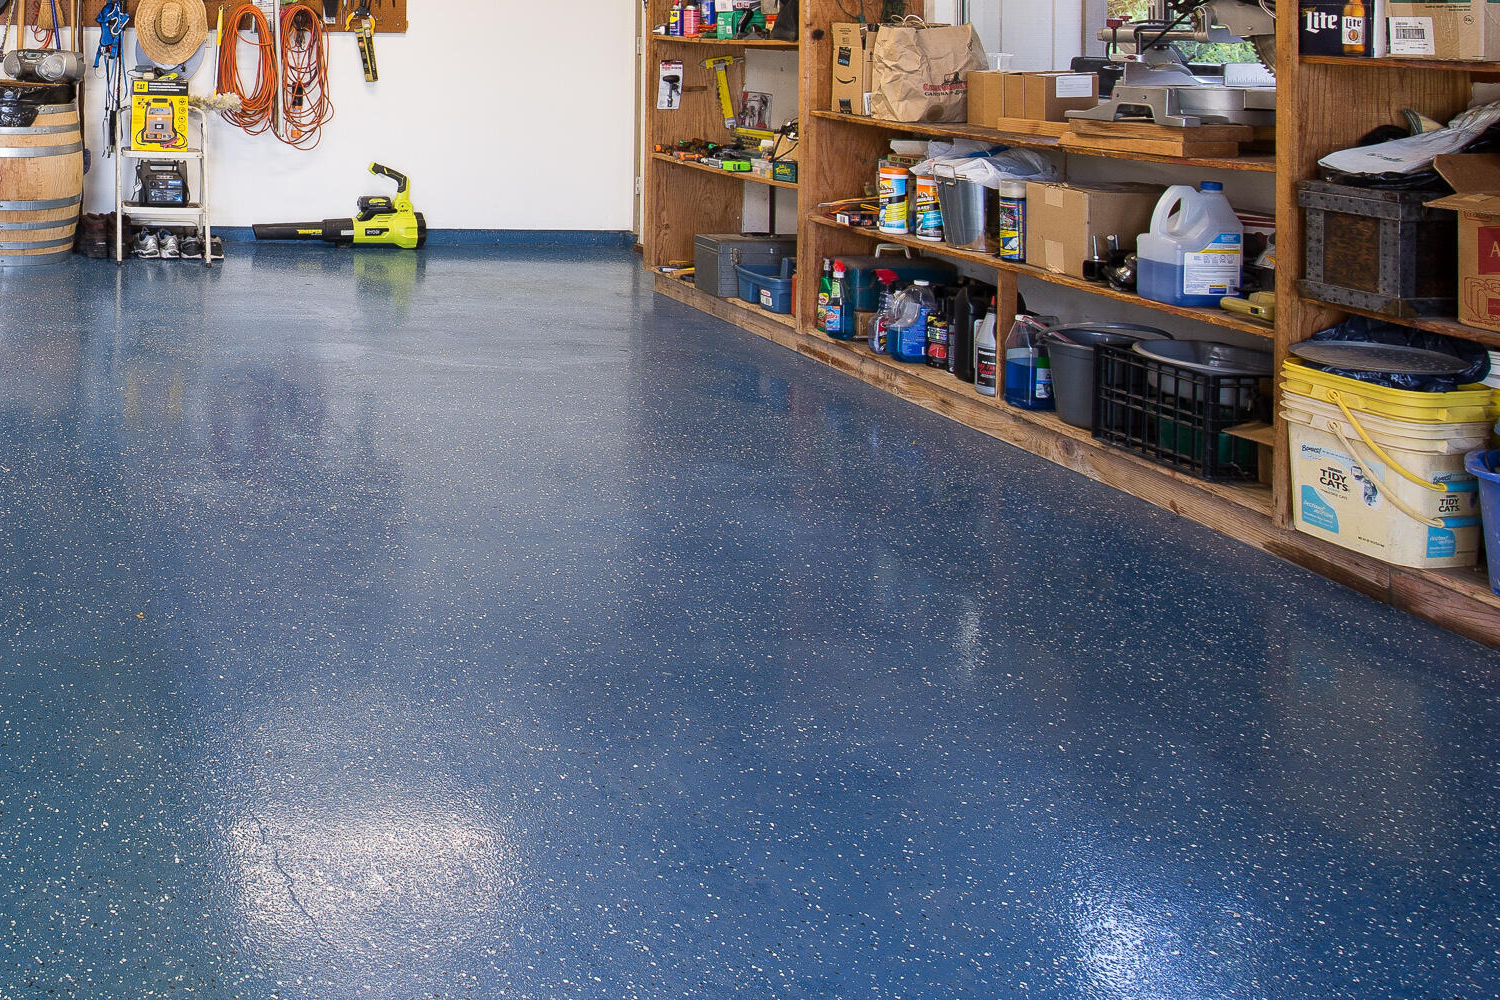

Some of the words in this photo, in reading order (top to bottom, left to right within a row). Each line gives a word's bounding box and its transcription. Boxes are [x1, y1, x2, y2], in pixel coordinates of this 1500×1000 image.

[1305, 11, 1338, 34] Lite
[1345, 18, 1362, 29] Lite
[1319, 468, 1348, 483] TIDY
[1319, 477, 1349, 492] CATS
[1440, 498, 1460, 506] TIDY
